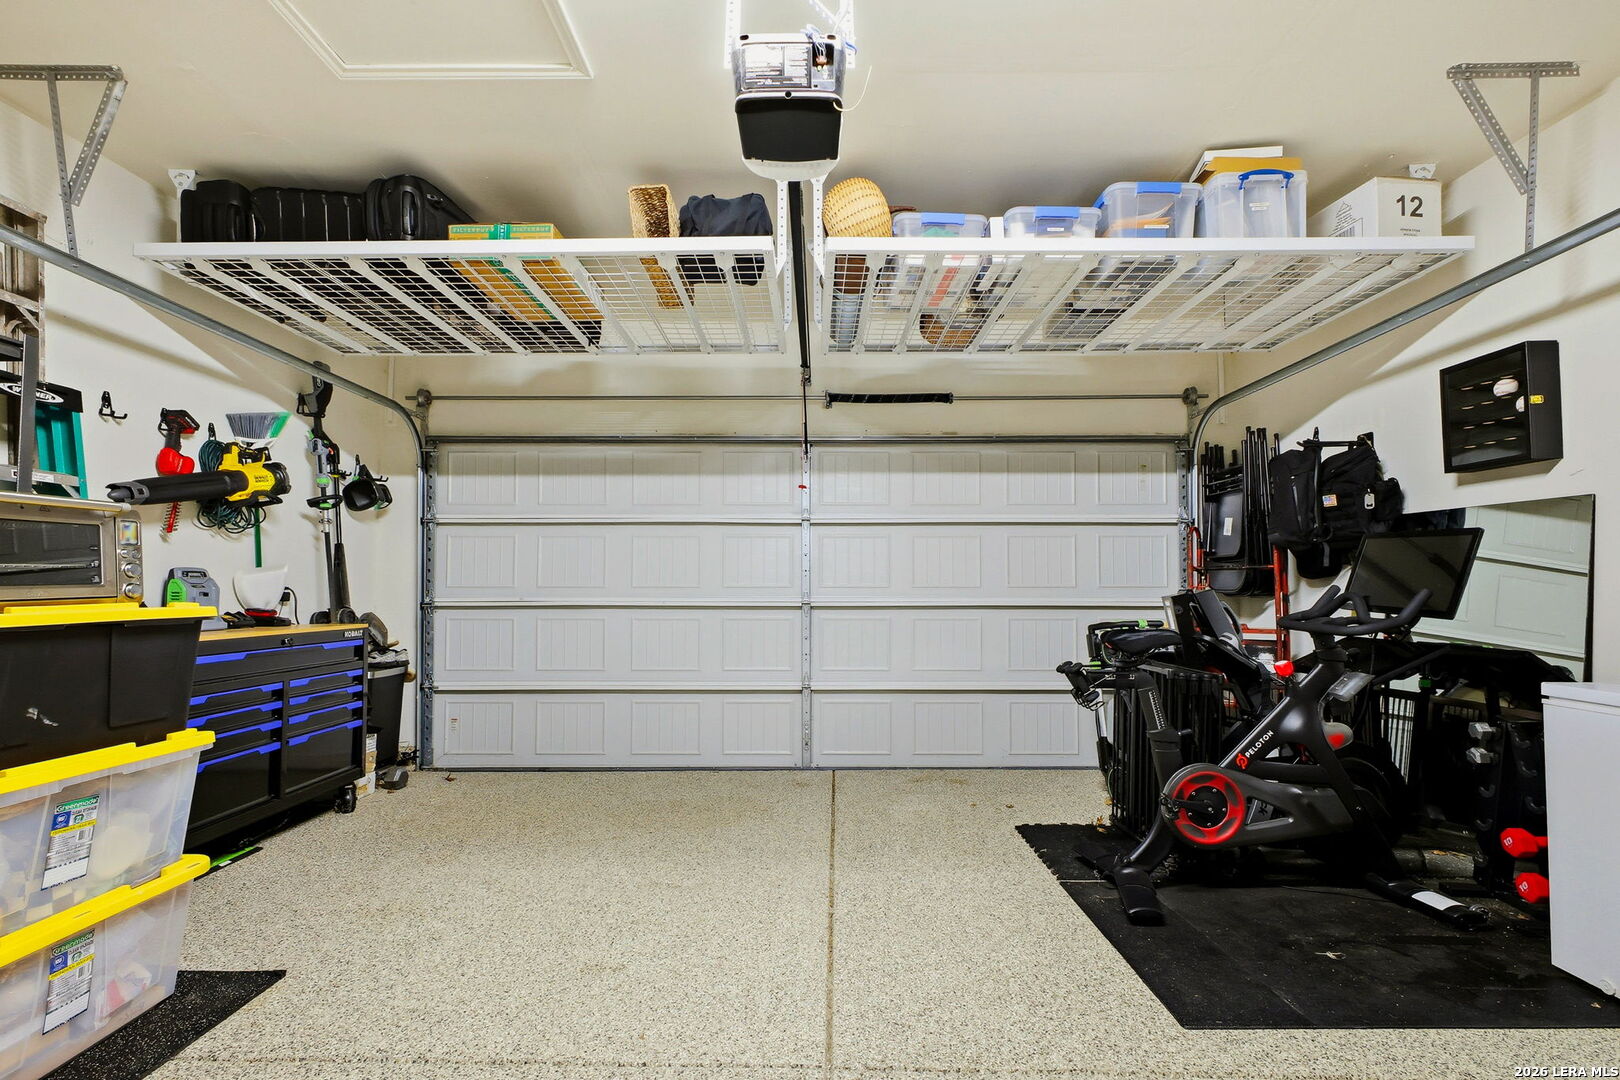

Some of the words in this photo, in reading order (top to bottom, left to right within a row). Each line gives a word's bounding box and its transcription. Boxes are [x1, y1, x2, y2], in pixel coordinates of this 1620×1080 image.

[1396, 194, 1424, 218] 12
[344, 630, 364, 638] KOBALT
[1244, 730, 1275, 758] PELOTON
[1503, 836, 1513, 847] 10
[1519, 881, 1529, 892] 10
